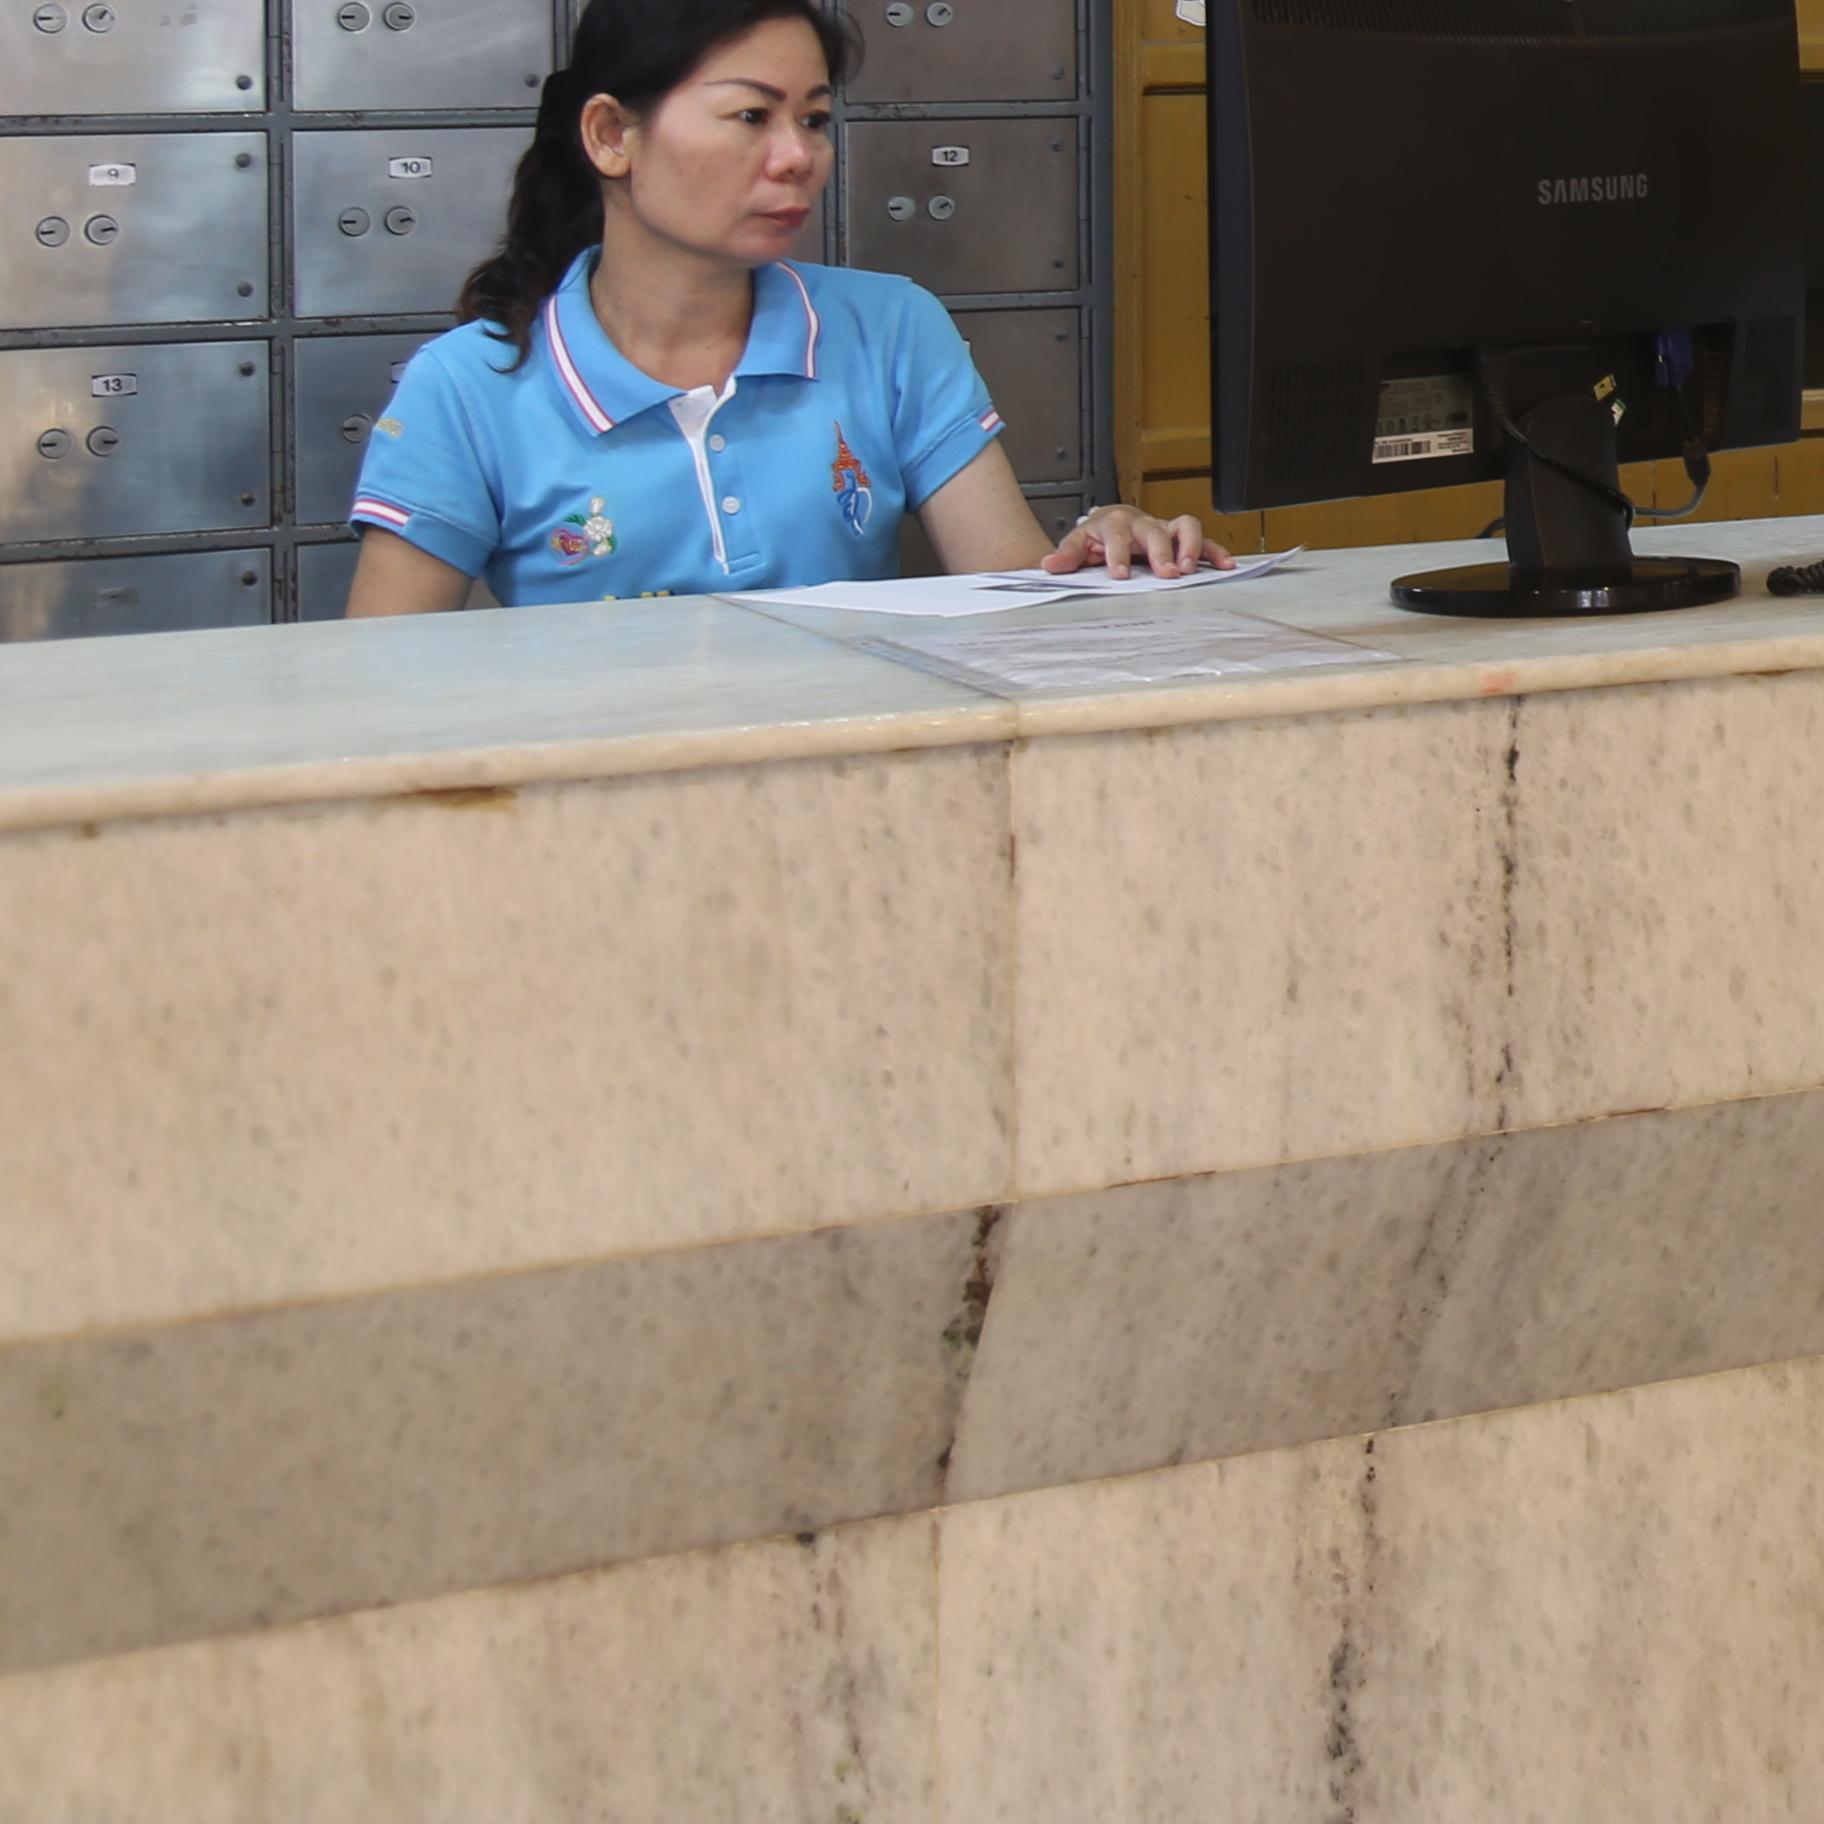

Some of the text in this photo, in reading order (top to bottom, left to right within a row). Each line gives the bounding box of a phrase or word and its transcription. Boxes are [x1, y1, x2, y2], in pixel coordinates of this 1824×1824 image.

[942, 149, 958, 162] 12
[402, 161, 420, 174] 10
[1539, 173, 1648, 204] SAMSUNG
[103, 379, 122, 392] 13
